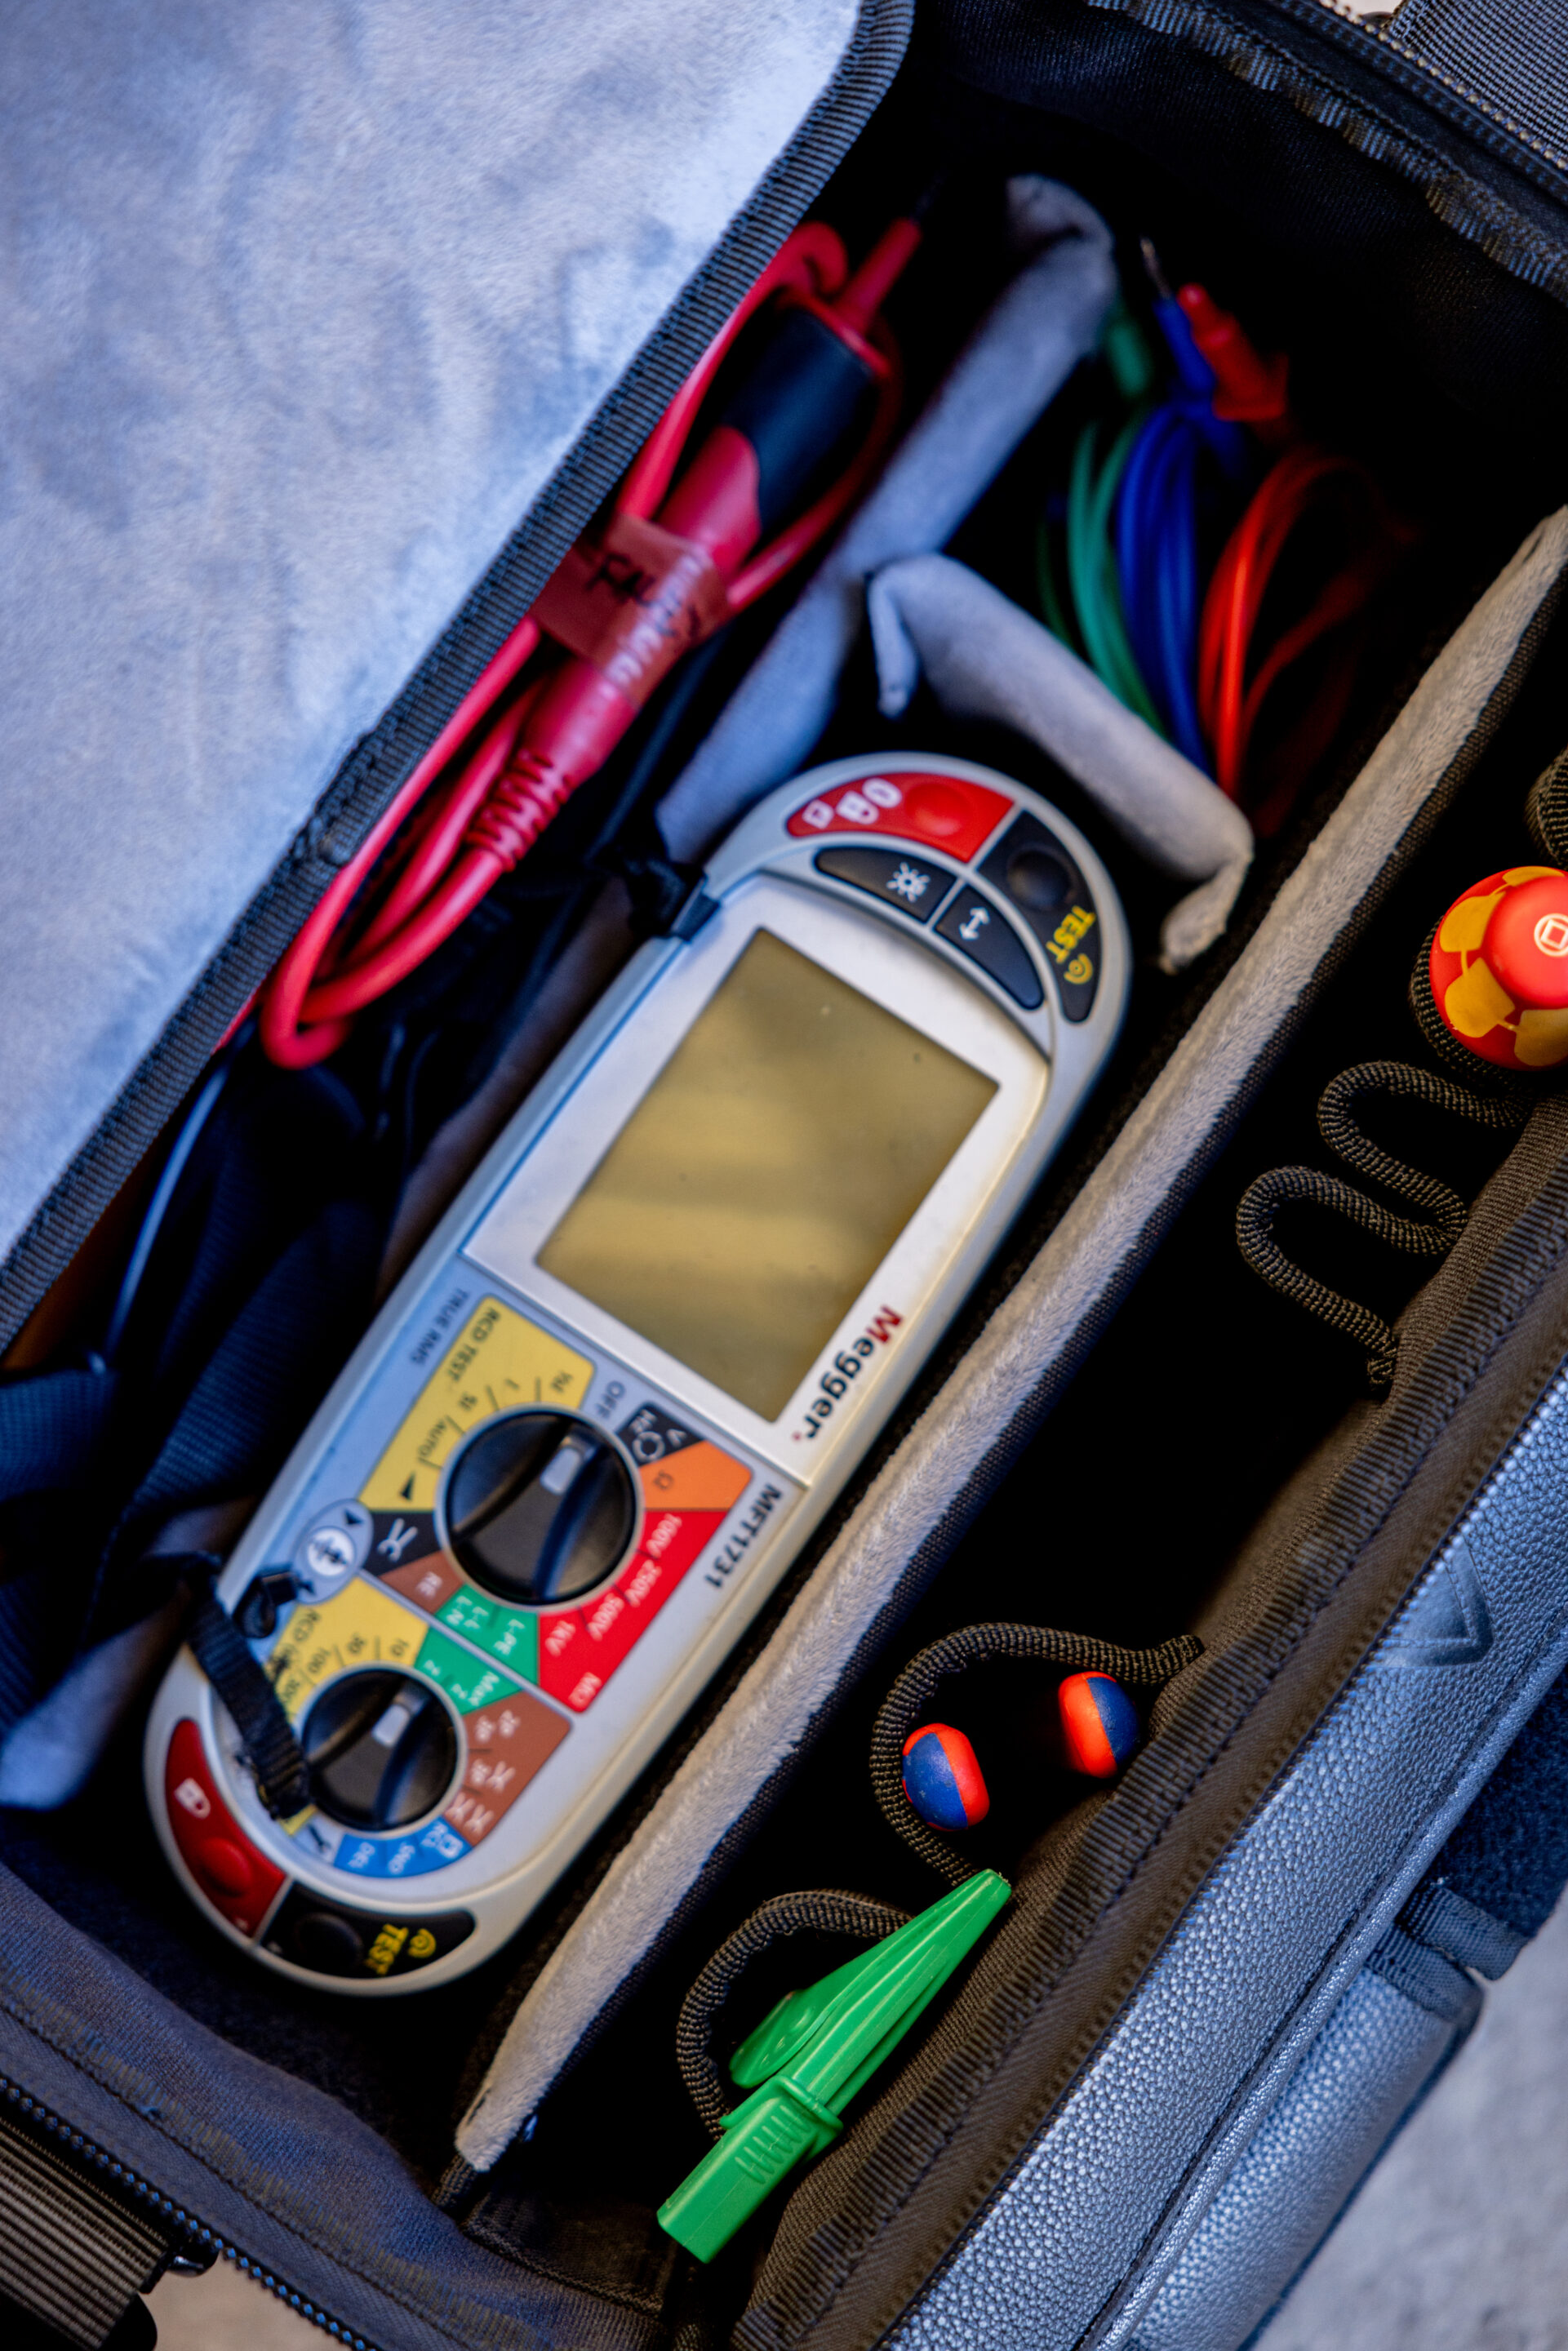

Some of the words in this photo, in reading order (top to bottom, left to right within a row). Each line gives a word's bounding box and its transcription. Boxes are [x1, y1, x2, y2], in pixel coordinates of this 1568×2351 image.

[1046, 905, 1095, 963] TEST
[434, 1286, 470, 1330] TRUE
[470, 1306, 501, 1344] RCD
[444, 1342, 478, 1383] TEST
[591, 1377, 629, 1422] OFF
[415, 1418, 450, 1460] AUTO
[643, 1509, 684, 1558] 100V
[702, 1481, 784, 1593] MFT1731
[620, 1558, 663, 1609] 250V
[583, 1591, 625, 1642] 500V
[366, 1923, 407, 1975] TEST
